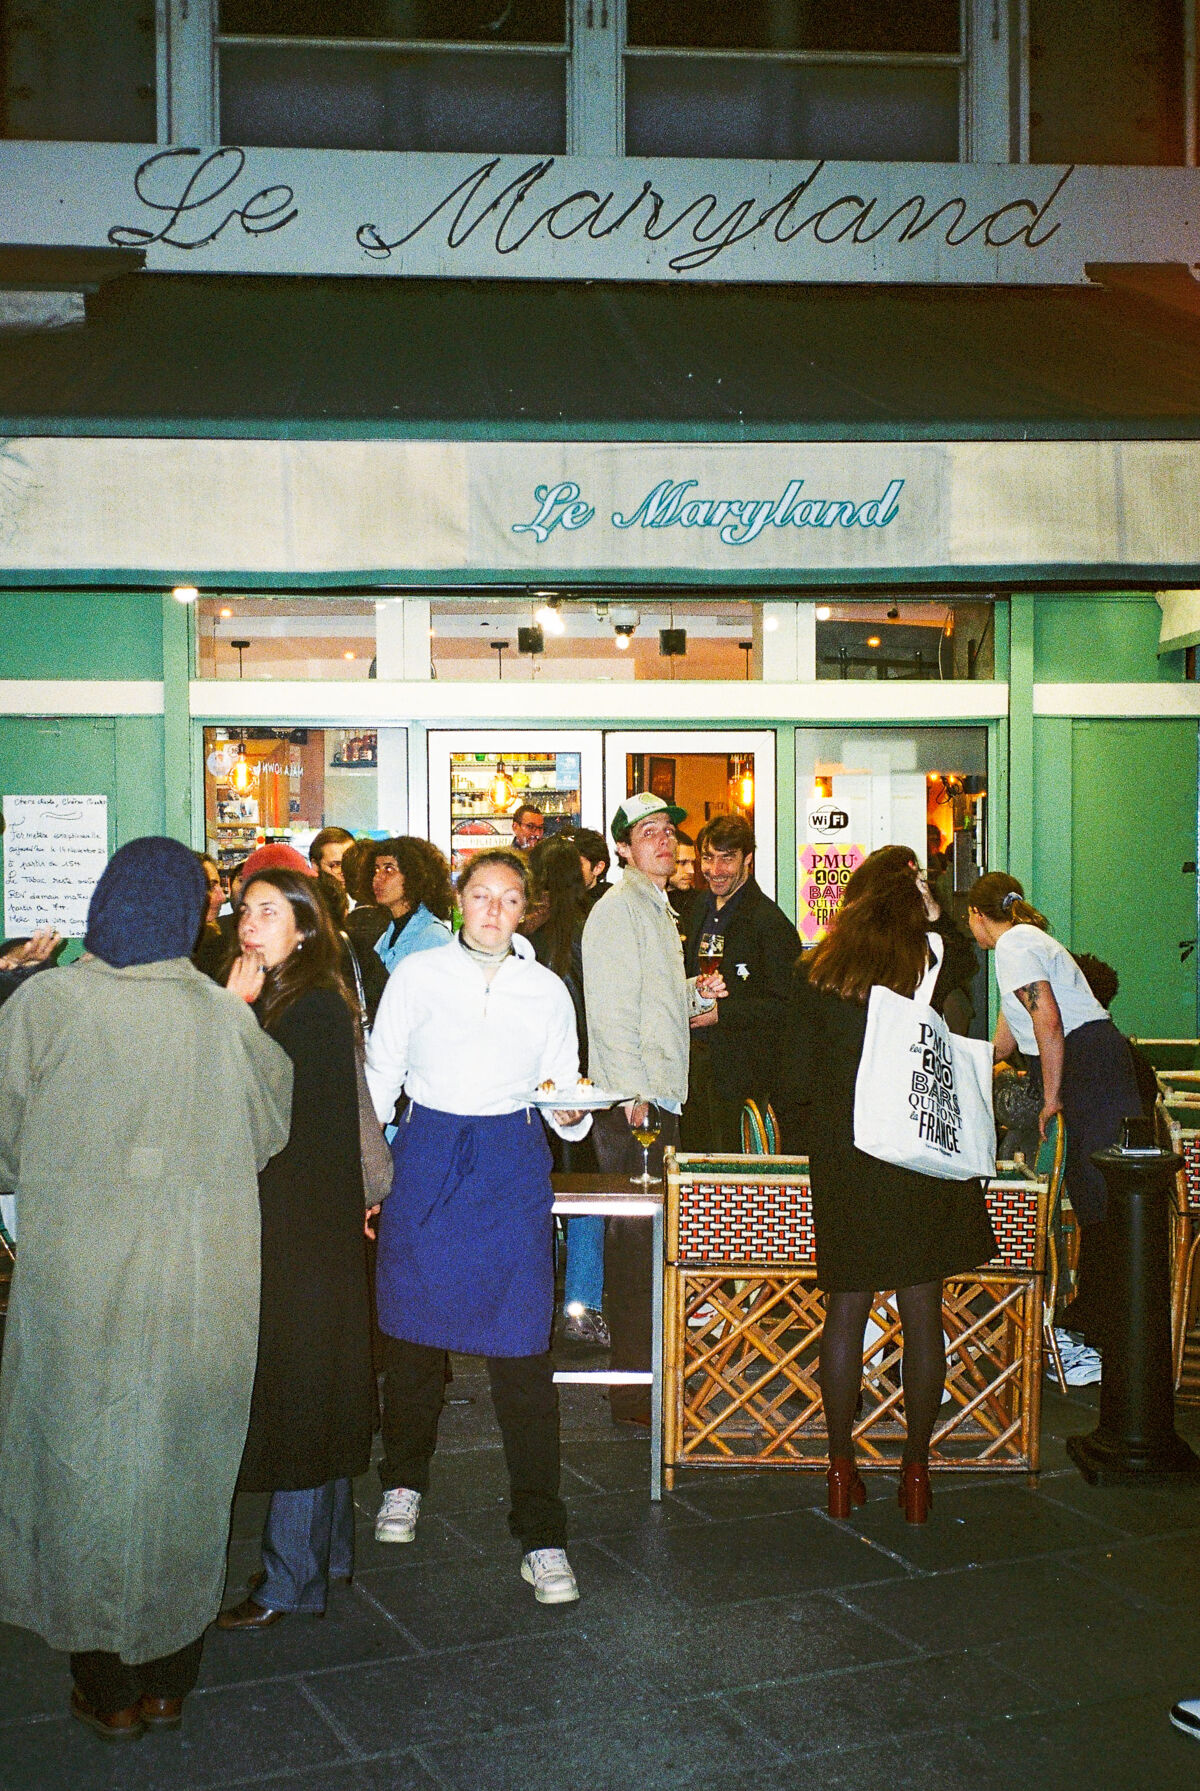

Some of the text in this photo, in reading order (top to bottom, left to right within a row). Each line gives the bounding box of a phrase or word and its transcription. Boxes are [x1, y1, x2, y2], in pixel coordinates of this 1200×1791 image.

[108, 147, 1075, 272] Le Maryland
[512, 479, 905, 546] Le Maryland
[811, 854, 854, 869] PMU
[815, 869, 851, 885] 100
[807, 900, 827, 910] QUI
[809, 885, 847, 899] BAR
[917, 1022, 953, 1066] PMU
[909, 1043, 953, 1090] les 100
[908, 1092, 963, 1130] QUI FONT
[911, 1070, 961, 1116] BARS
[909, 1110, 919, 1121] la
[918, 1110, 962, 1154] FRANCE
